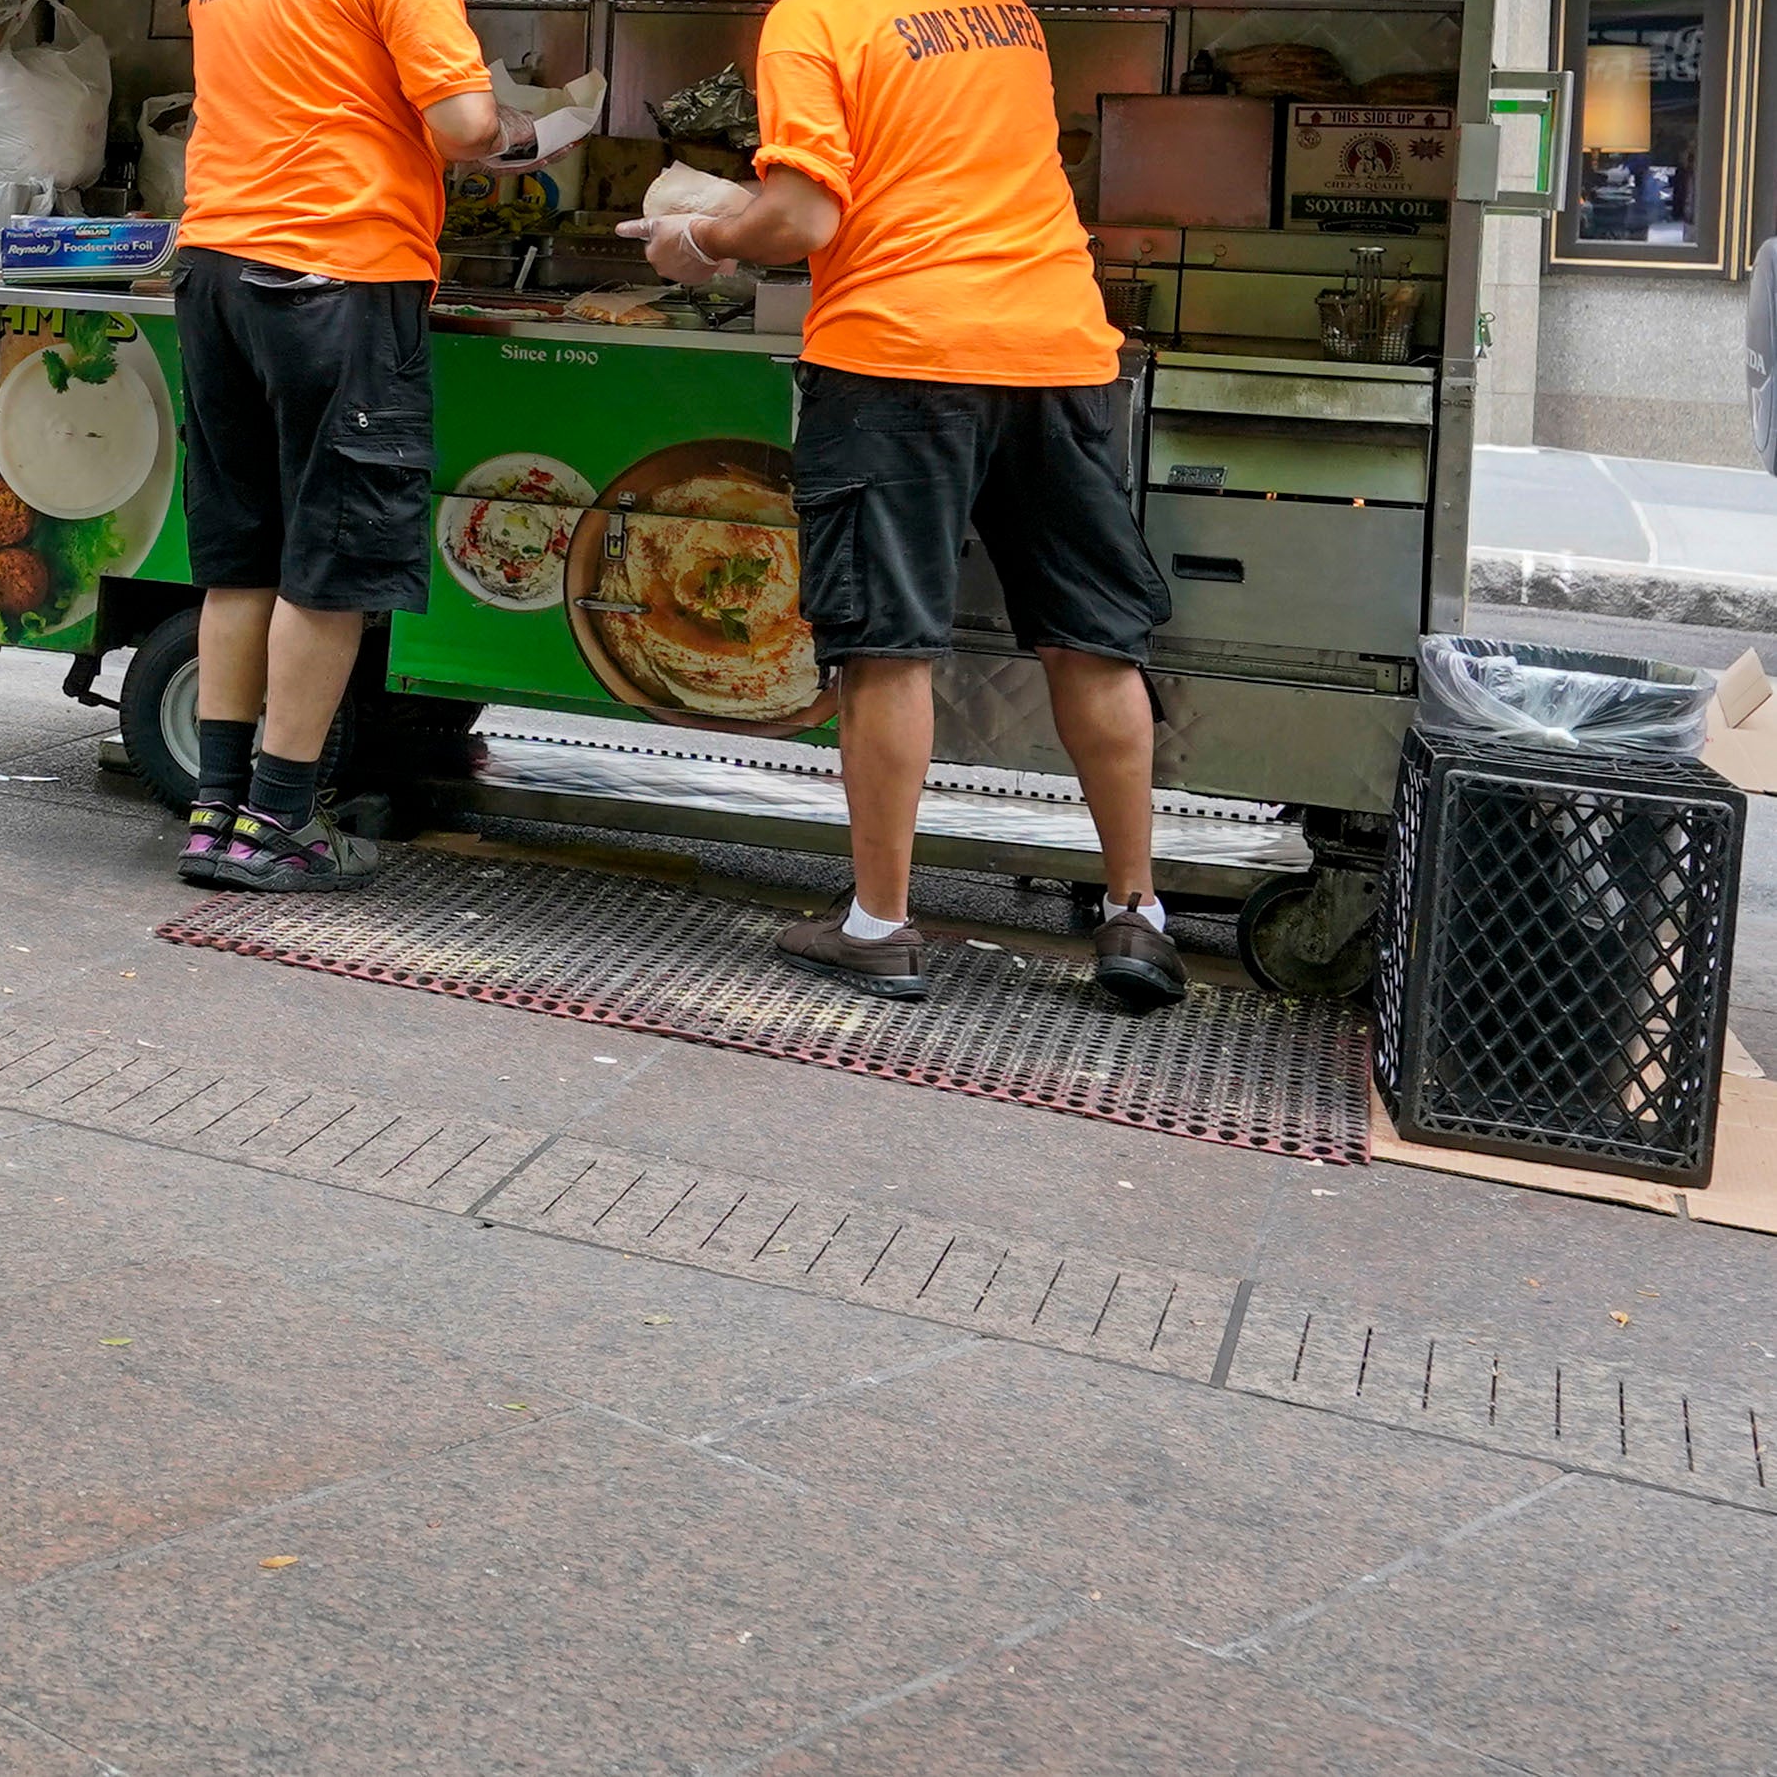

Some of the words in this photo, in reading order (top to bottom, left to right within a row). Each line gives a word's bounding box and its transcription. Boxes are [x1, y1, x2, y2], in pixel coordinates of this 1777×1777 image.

[894, 8, 970, 62] SAM'S
[958, 3, 1045, 54] FALAFEL
[1330, 110, 1359, 123] THIS
[1363, 111, 1393, 124] SIDE
[1397, 112, 1416, 124] UP
[1365, 181, 1414, 192] QUALITY
[1304, 198, 1395, 215] SOYBEAN
[1399, 201, 1434, 217] OIL
[5, 231, 34, 239] Premium
[63, 241, 129, 253] Foodservice
[132, 240, 154, 251] Foil
[500, 343, 547, 363] Since
[553, 348, 599, 367] 1990
